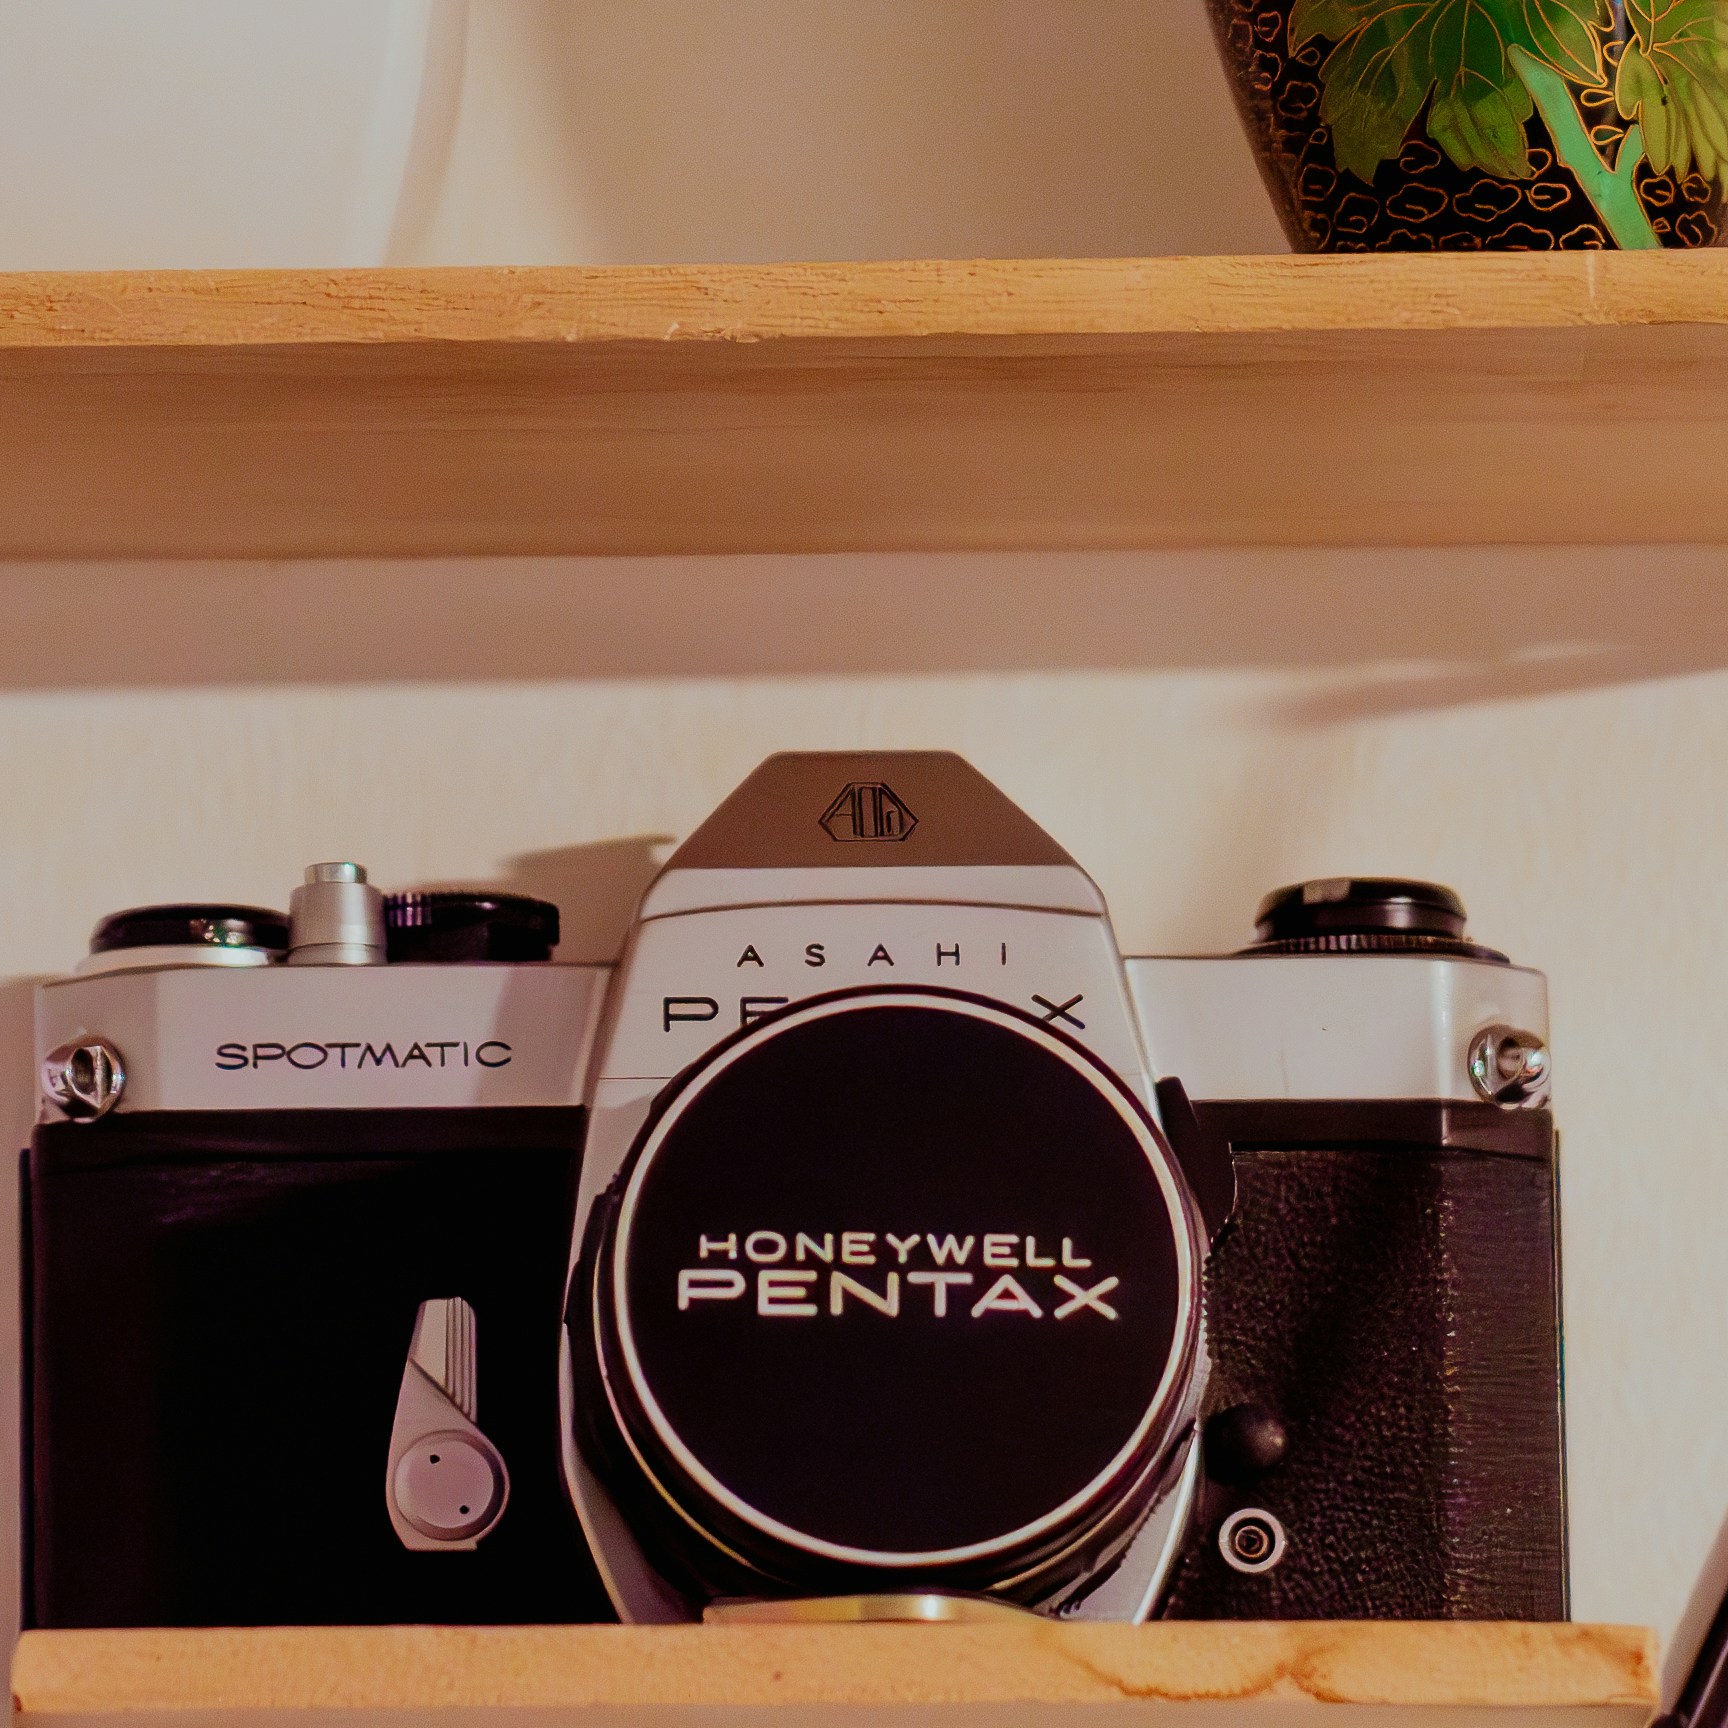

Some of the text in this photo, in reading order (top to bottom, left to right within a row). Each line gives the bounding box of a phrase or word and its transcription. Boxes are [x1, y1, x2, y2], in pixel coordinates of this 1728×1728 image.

[737, 943, 1008, 968] ASAHI
[663, 994, 1085, 1032] PEX
[215, 1041, 512, 1071] SPOTMATIC
[698, 1231, 1092, 1267] HONEYWELL
[677, 1269, 1120, 1320] PENTAX
